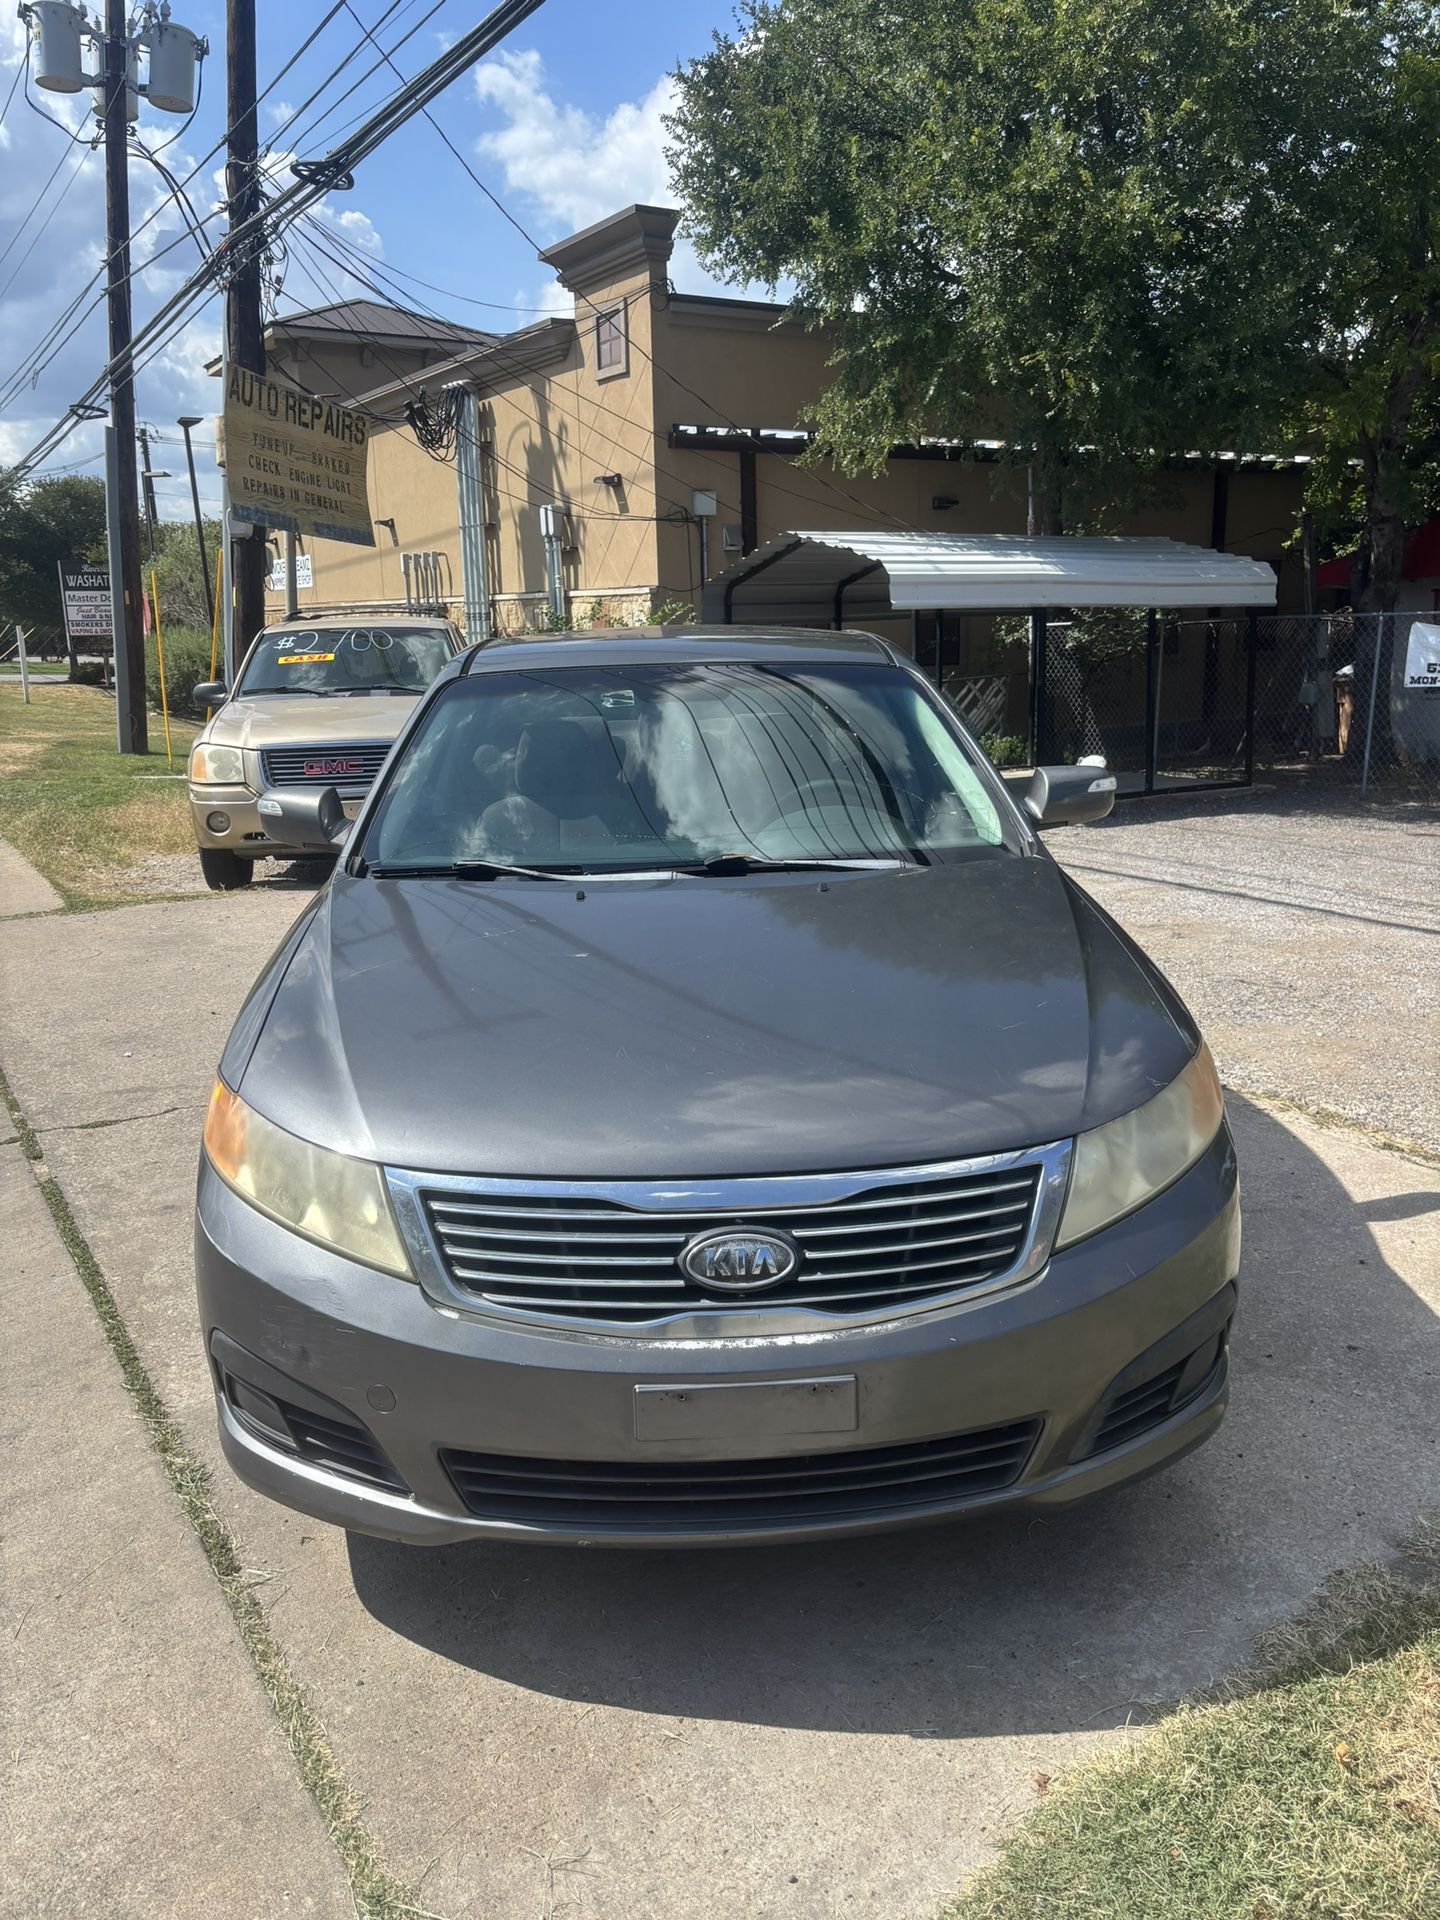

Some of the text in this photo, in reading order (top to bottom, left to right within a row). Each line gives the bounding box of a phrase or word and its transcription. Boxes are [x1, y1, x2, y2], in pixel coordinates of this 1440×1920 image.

[229, 367, 367, 446] AUTO REPAIRS
[248, 455, 281, 477] CHECK
[311, 451, 351, 475] BRAKES
[304, 491, 345, 514] GENERAL
[65, 574, 111, 587] WASHAT
[67, 593, 98, 603] Master
[284, 654, 329, 663] CASH
[303, 758, 364, 775] GMC
[704, 1244, 778, 1277] KIA
